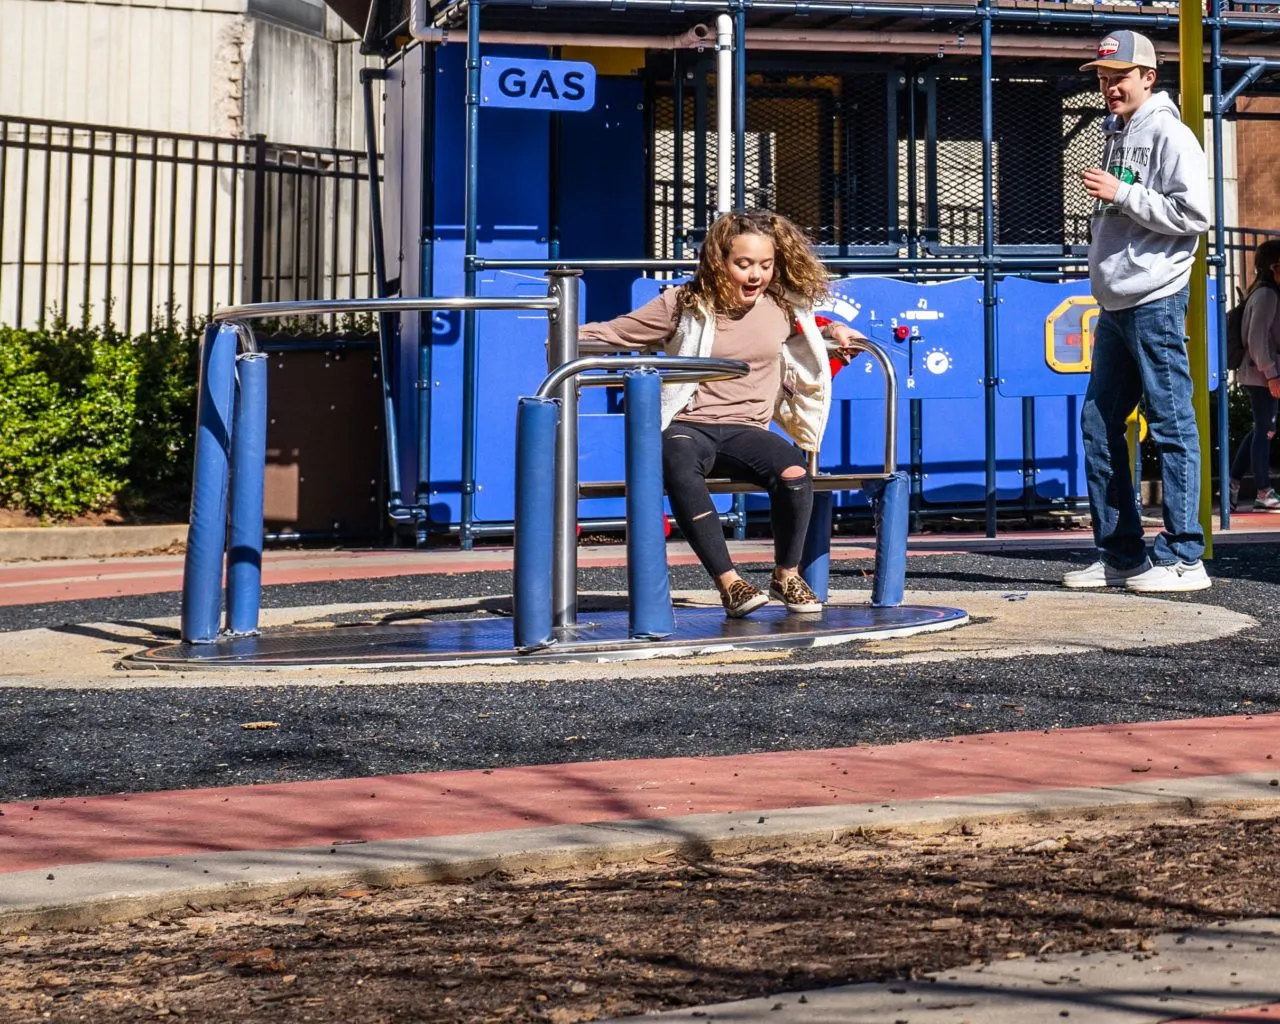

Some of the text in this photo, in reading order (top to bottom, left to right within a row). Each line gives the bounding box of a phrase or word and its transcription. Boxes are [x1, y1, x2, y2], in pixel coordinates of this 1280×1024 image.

[498, 67, 586, 101] GAS
[870, 310, 876, 320] 1
[890, 318, 898, 328] 3
[911, 326, 919, 336] 5
[865, 363, 873, 373] 2
[907, 378, 915, 389] R
